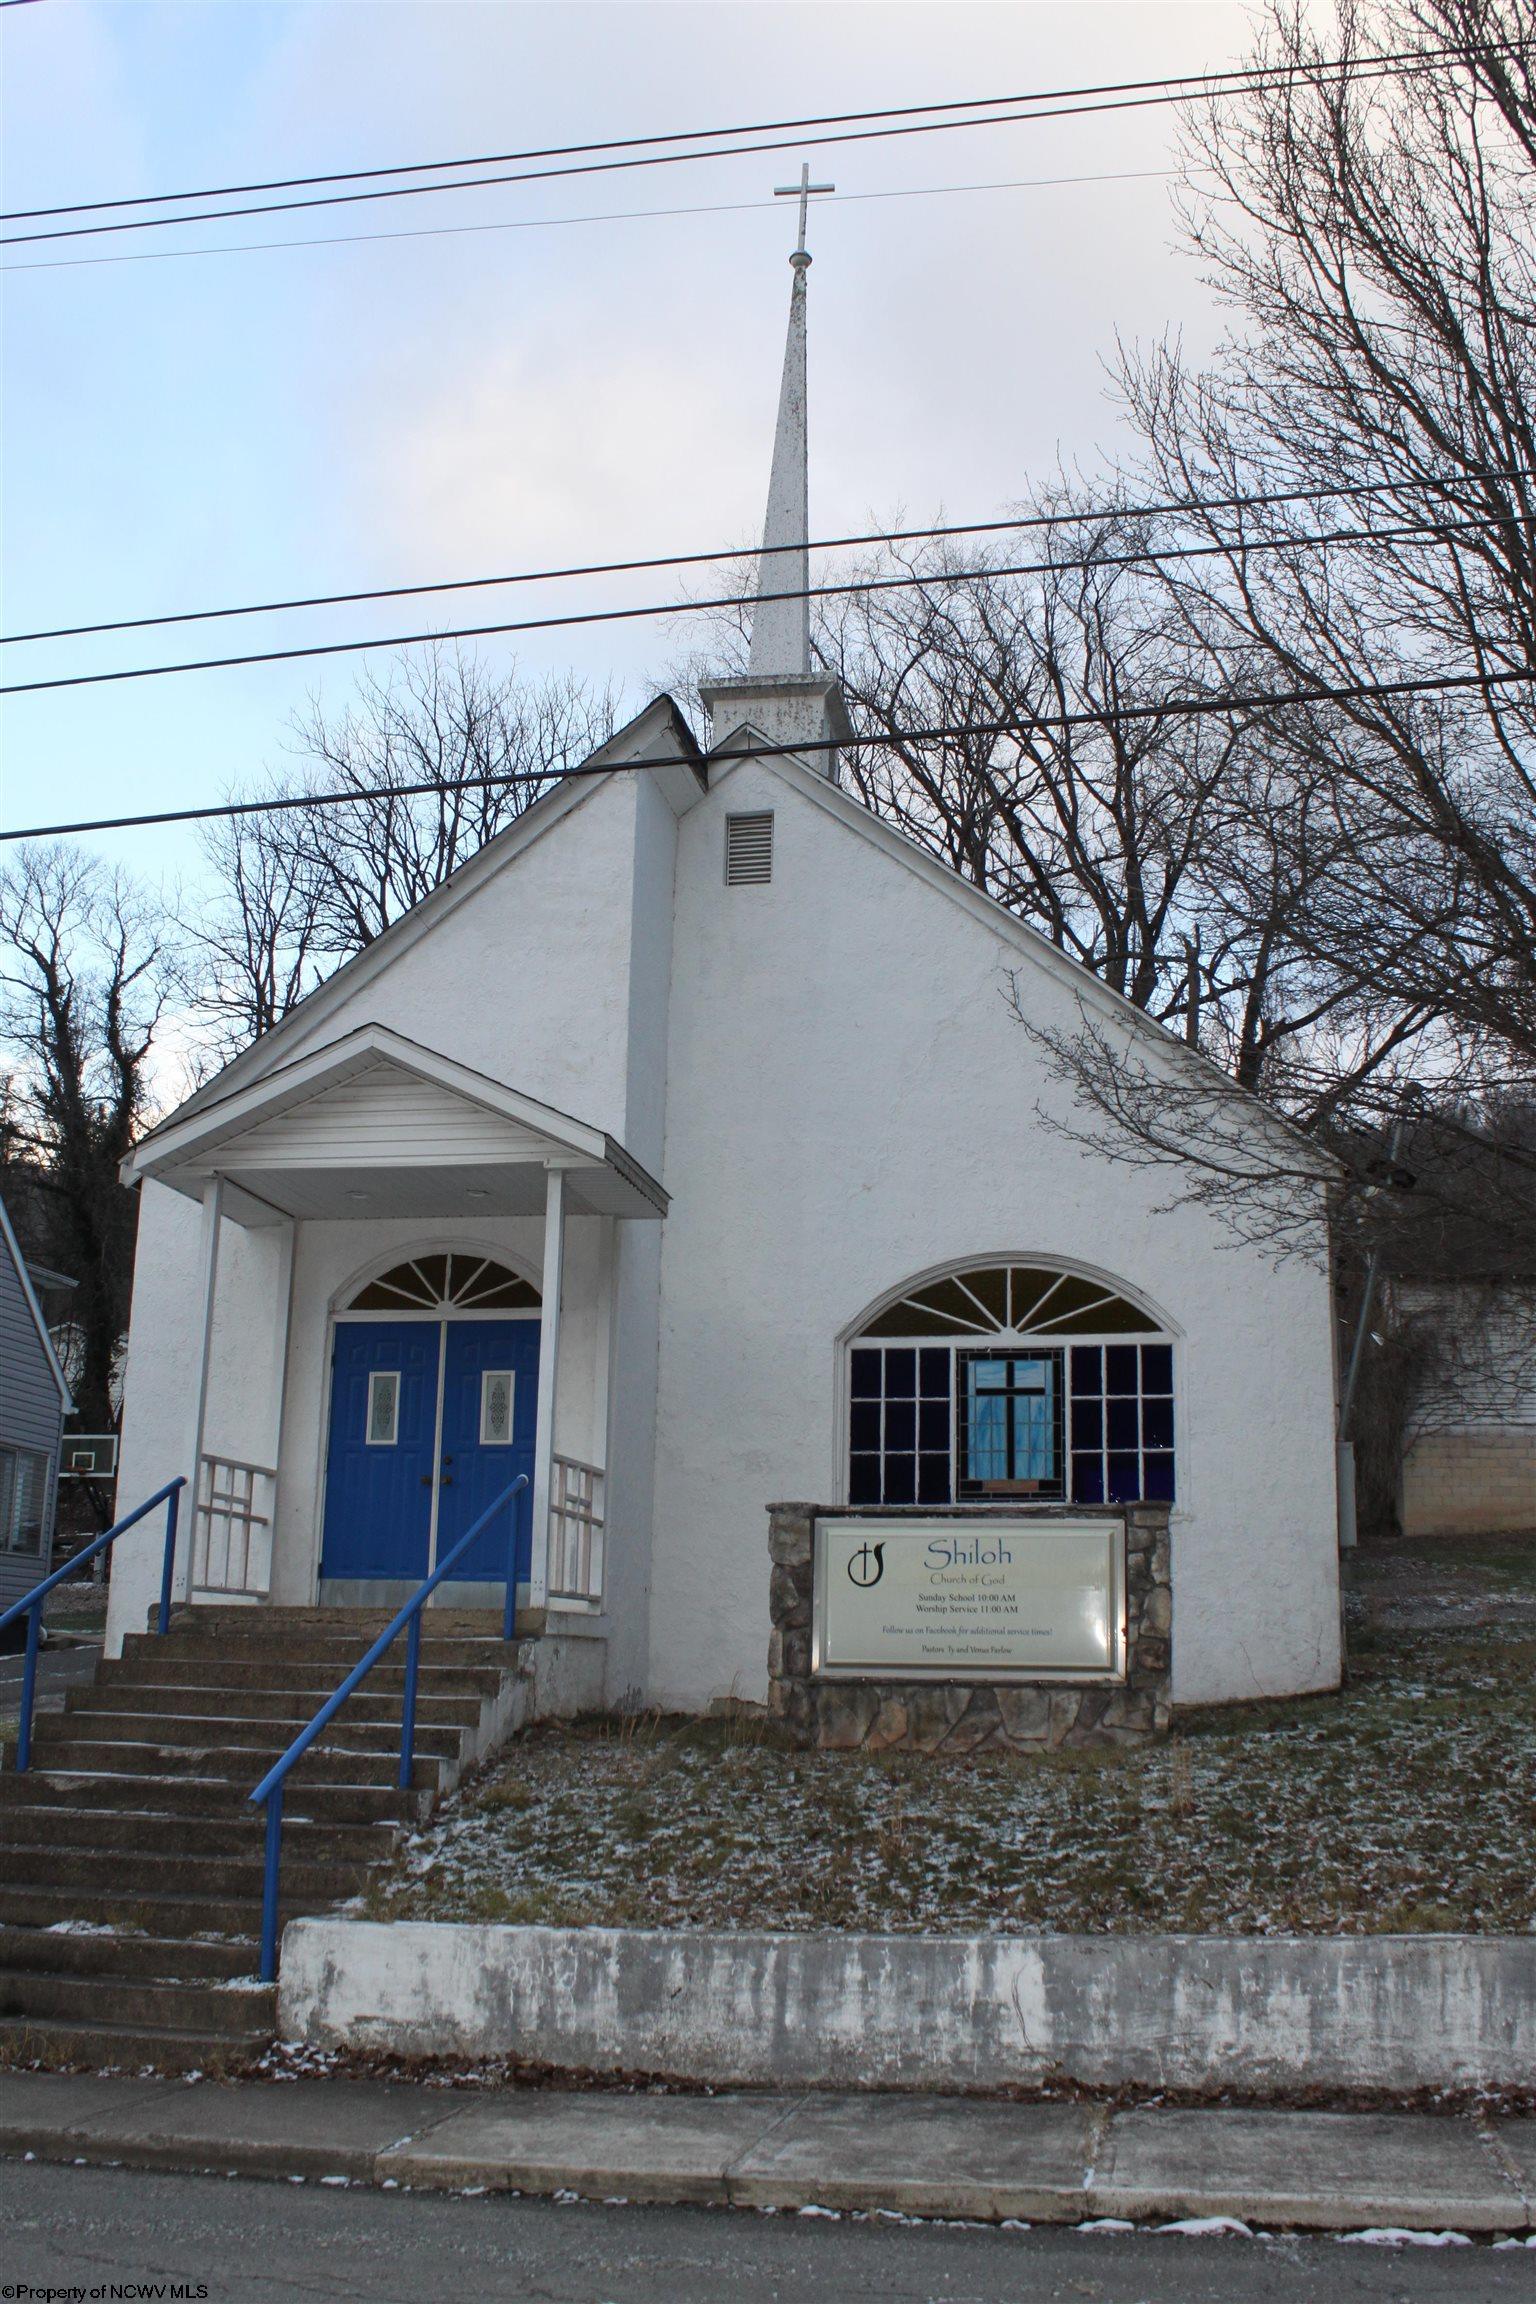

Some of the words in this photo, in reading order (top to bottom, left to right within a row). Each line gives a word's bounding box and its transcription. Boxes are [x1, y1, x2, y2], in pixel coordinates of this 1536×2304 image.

[924, 1538, 1012, 1570] Shiloh
[930, 1573, 967, 1585] Church
[968, 1573, 979, 1585] of
[981, 1574, 1005, 1586] God
[919, 1593, 946, 1603] Sunday
[949, 1593, 975, 1602] School
[978, 1594, 999, 1602] 10:00
[1001, 1594, 1016, 1602] AM
[916, 1605, 948, 1614] Worship
[949, 1605, 978, 1614] Service
[981, 1605, 1001, 1613] 11:00
[1003, 1605, 1018, 1613] AM
[882, 1625, 903, 1634] Follow
[925, 1626, 957, 1634] Facebook
